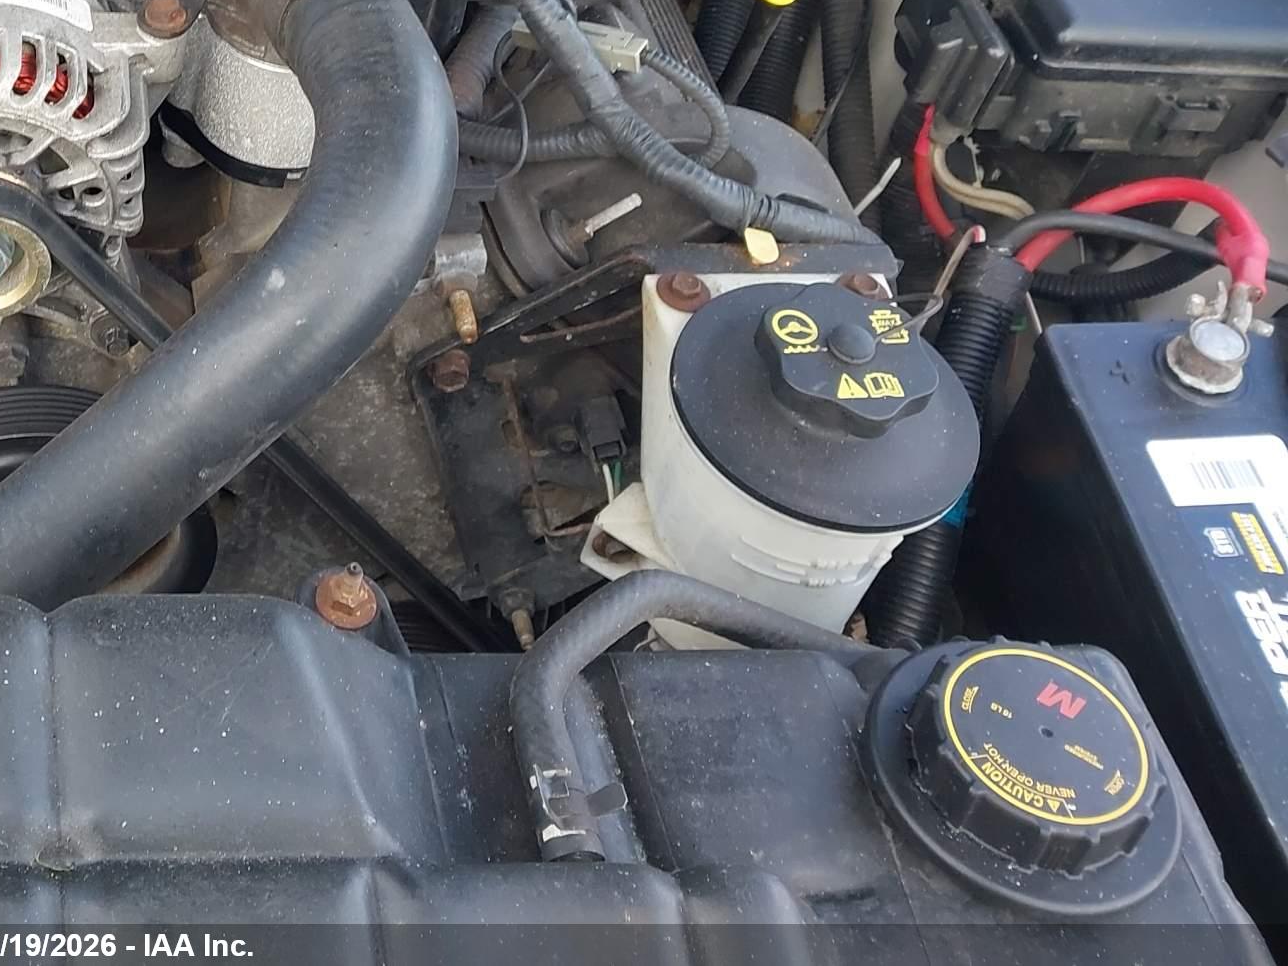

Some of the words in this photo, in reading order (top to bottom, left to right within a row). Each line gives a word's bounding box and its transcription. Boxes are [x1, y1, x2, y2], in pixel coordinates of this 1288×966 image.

[983, 742, 1005, 765] HOT
[980, 760, 1044, 808] CAUTION
[1001, 760, 1035, 787] OPEN
[1035, 780, 1077, 799] NEVER
